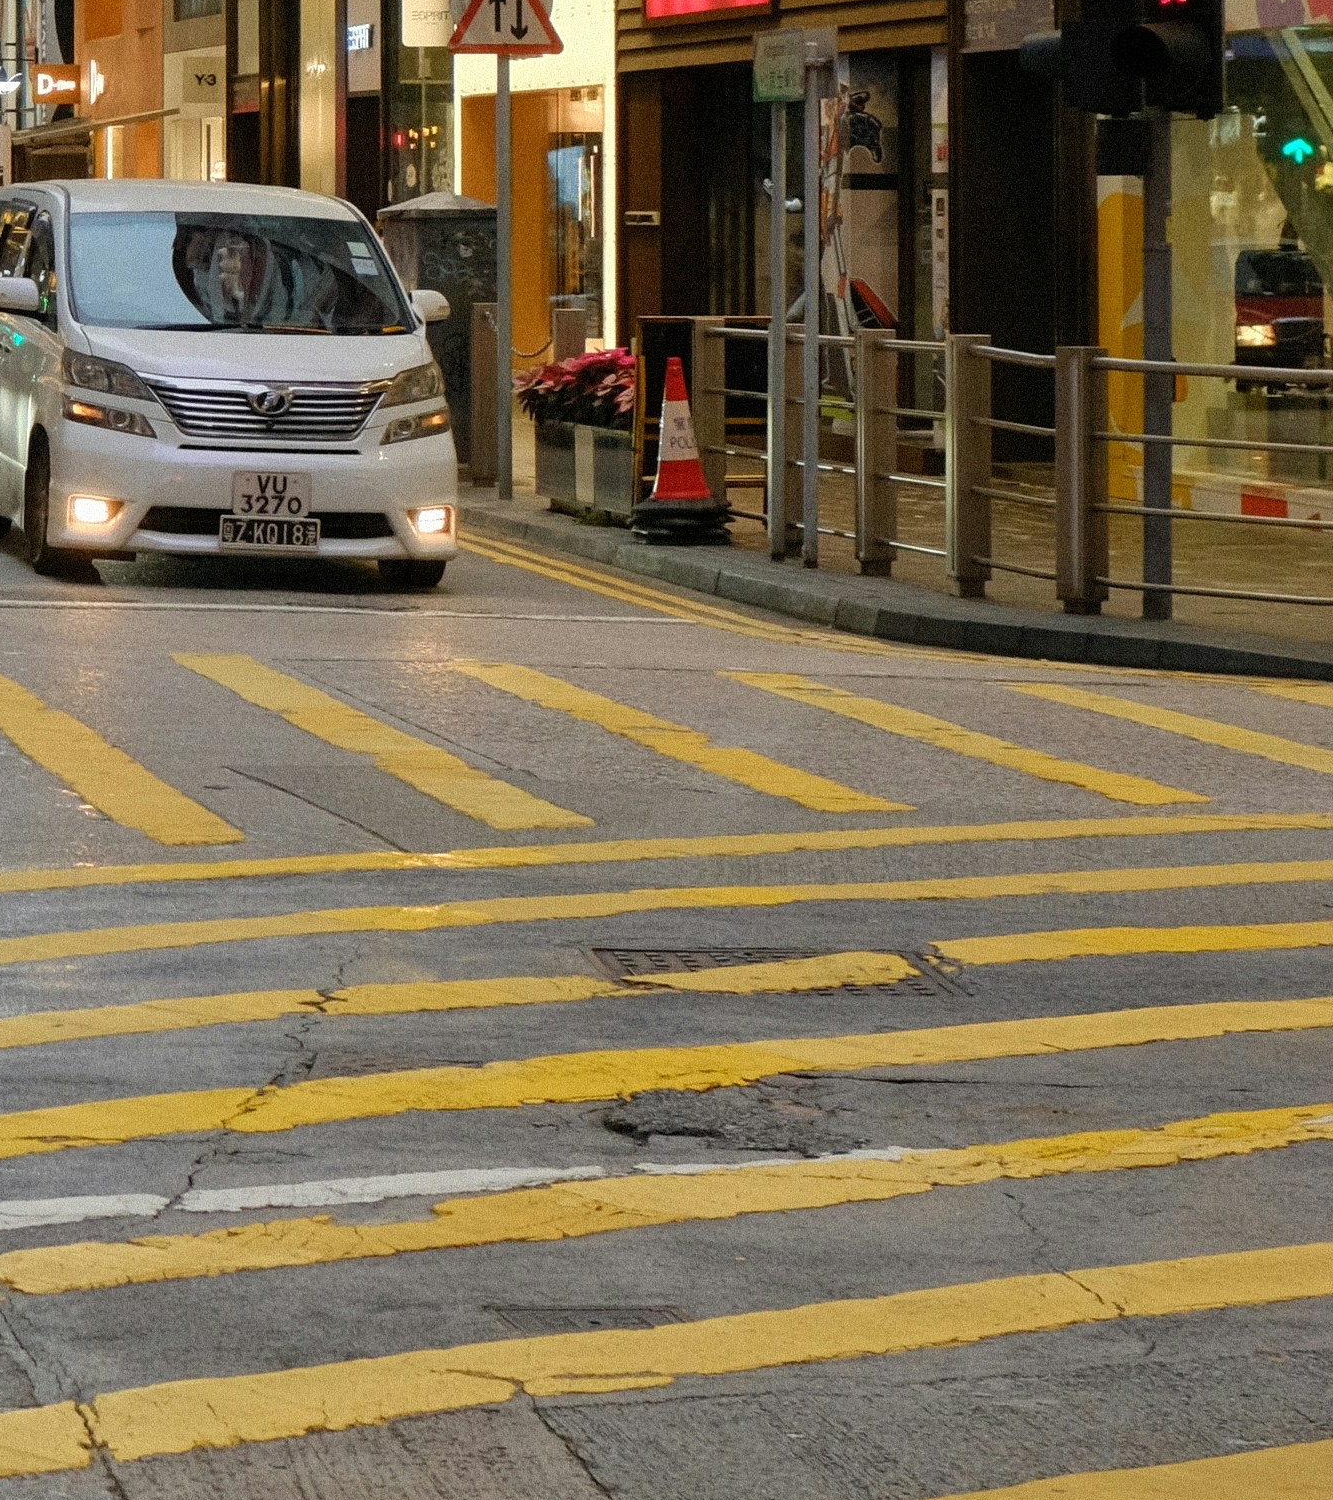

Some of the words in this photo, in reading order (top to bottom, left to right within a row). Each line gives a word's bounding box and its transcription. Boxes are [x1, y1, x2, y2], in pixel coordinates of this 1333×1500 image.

[410, 10, 450, 22] ESPRIT
[193, 73, 217, 87] Y-3
[257, 474, 288, 494] VU
[240, 494, 302, 514] 3270
